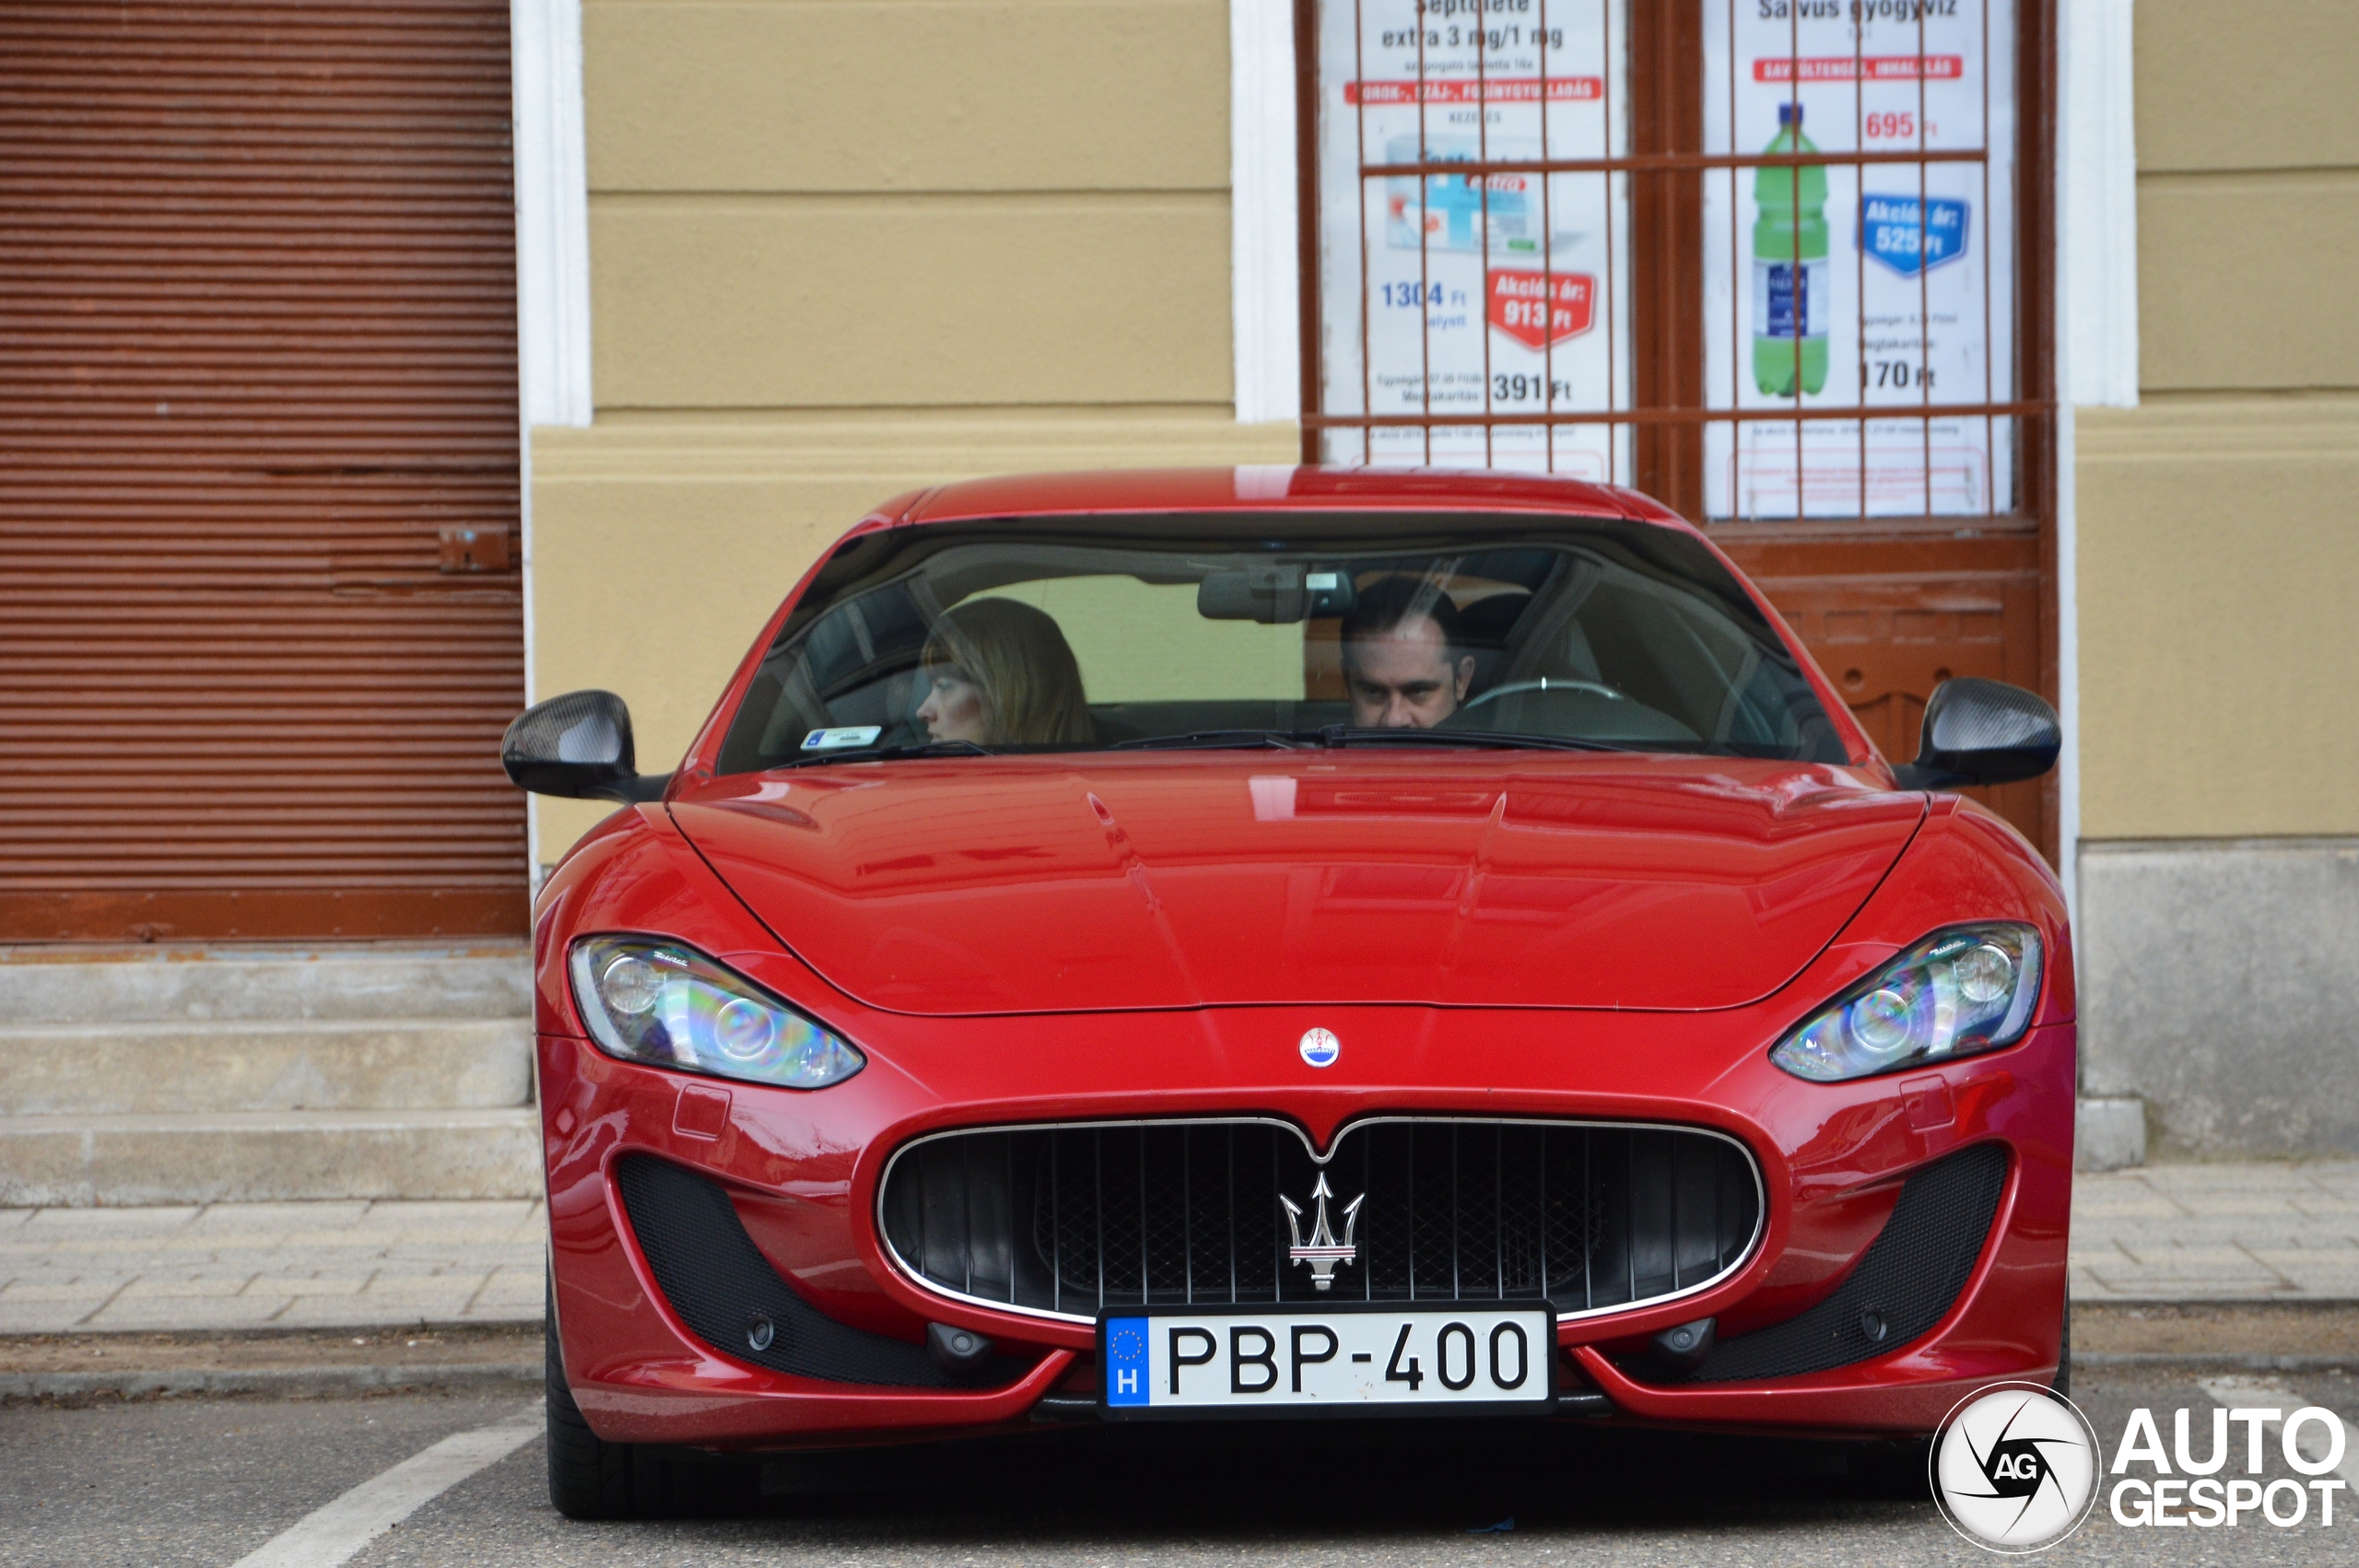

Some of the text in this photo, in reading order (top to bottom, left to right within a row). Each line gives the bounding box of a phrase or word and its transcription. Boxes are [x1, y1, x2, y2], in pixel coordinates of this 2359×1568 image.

[1758, 0, 1840, 18] Savus
[1448, 26, 1461, 46] 3
[1866, 112, 1914, 137] 695
[1876, 225, 1920, 253] 525
[1382, 281, 1443, 308] 1304
[1504, 299, 1572, 330] 913 Ft
[1495, 374, 1571, 401] 391 Ft
[1168, 1320, 1529, 1396] PBP-400
[1117, 1369, 1137, 1394] H
